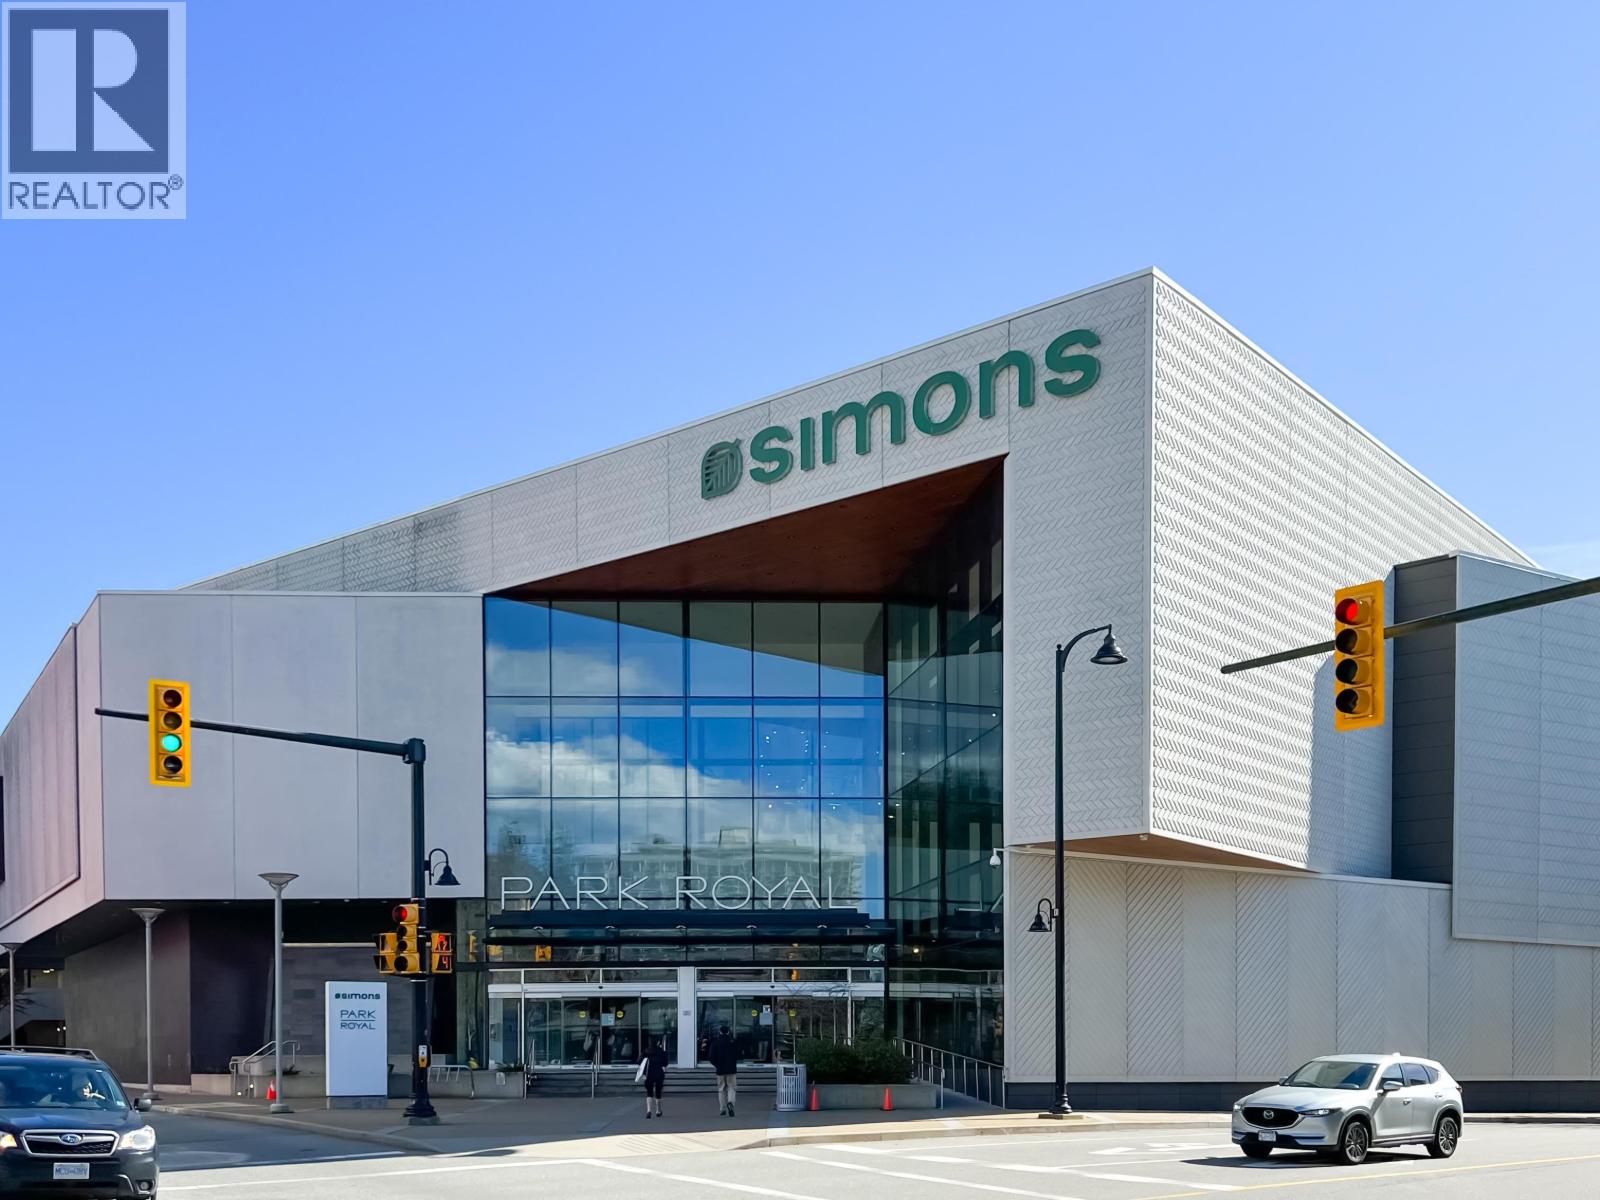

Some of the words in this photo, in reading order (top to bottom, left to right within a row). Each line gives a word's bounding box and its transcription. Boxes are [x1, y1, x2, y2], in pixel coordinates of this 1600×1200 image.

[500, 875, 650, 911] PARK
[676, 875, 860, 911] ROYAL
[340, 1009, 377, 1019] PARK
[340, 1022, 377, 1030] ROYAL
